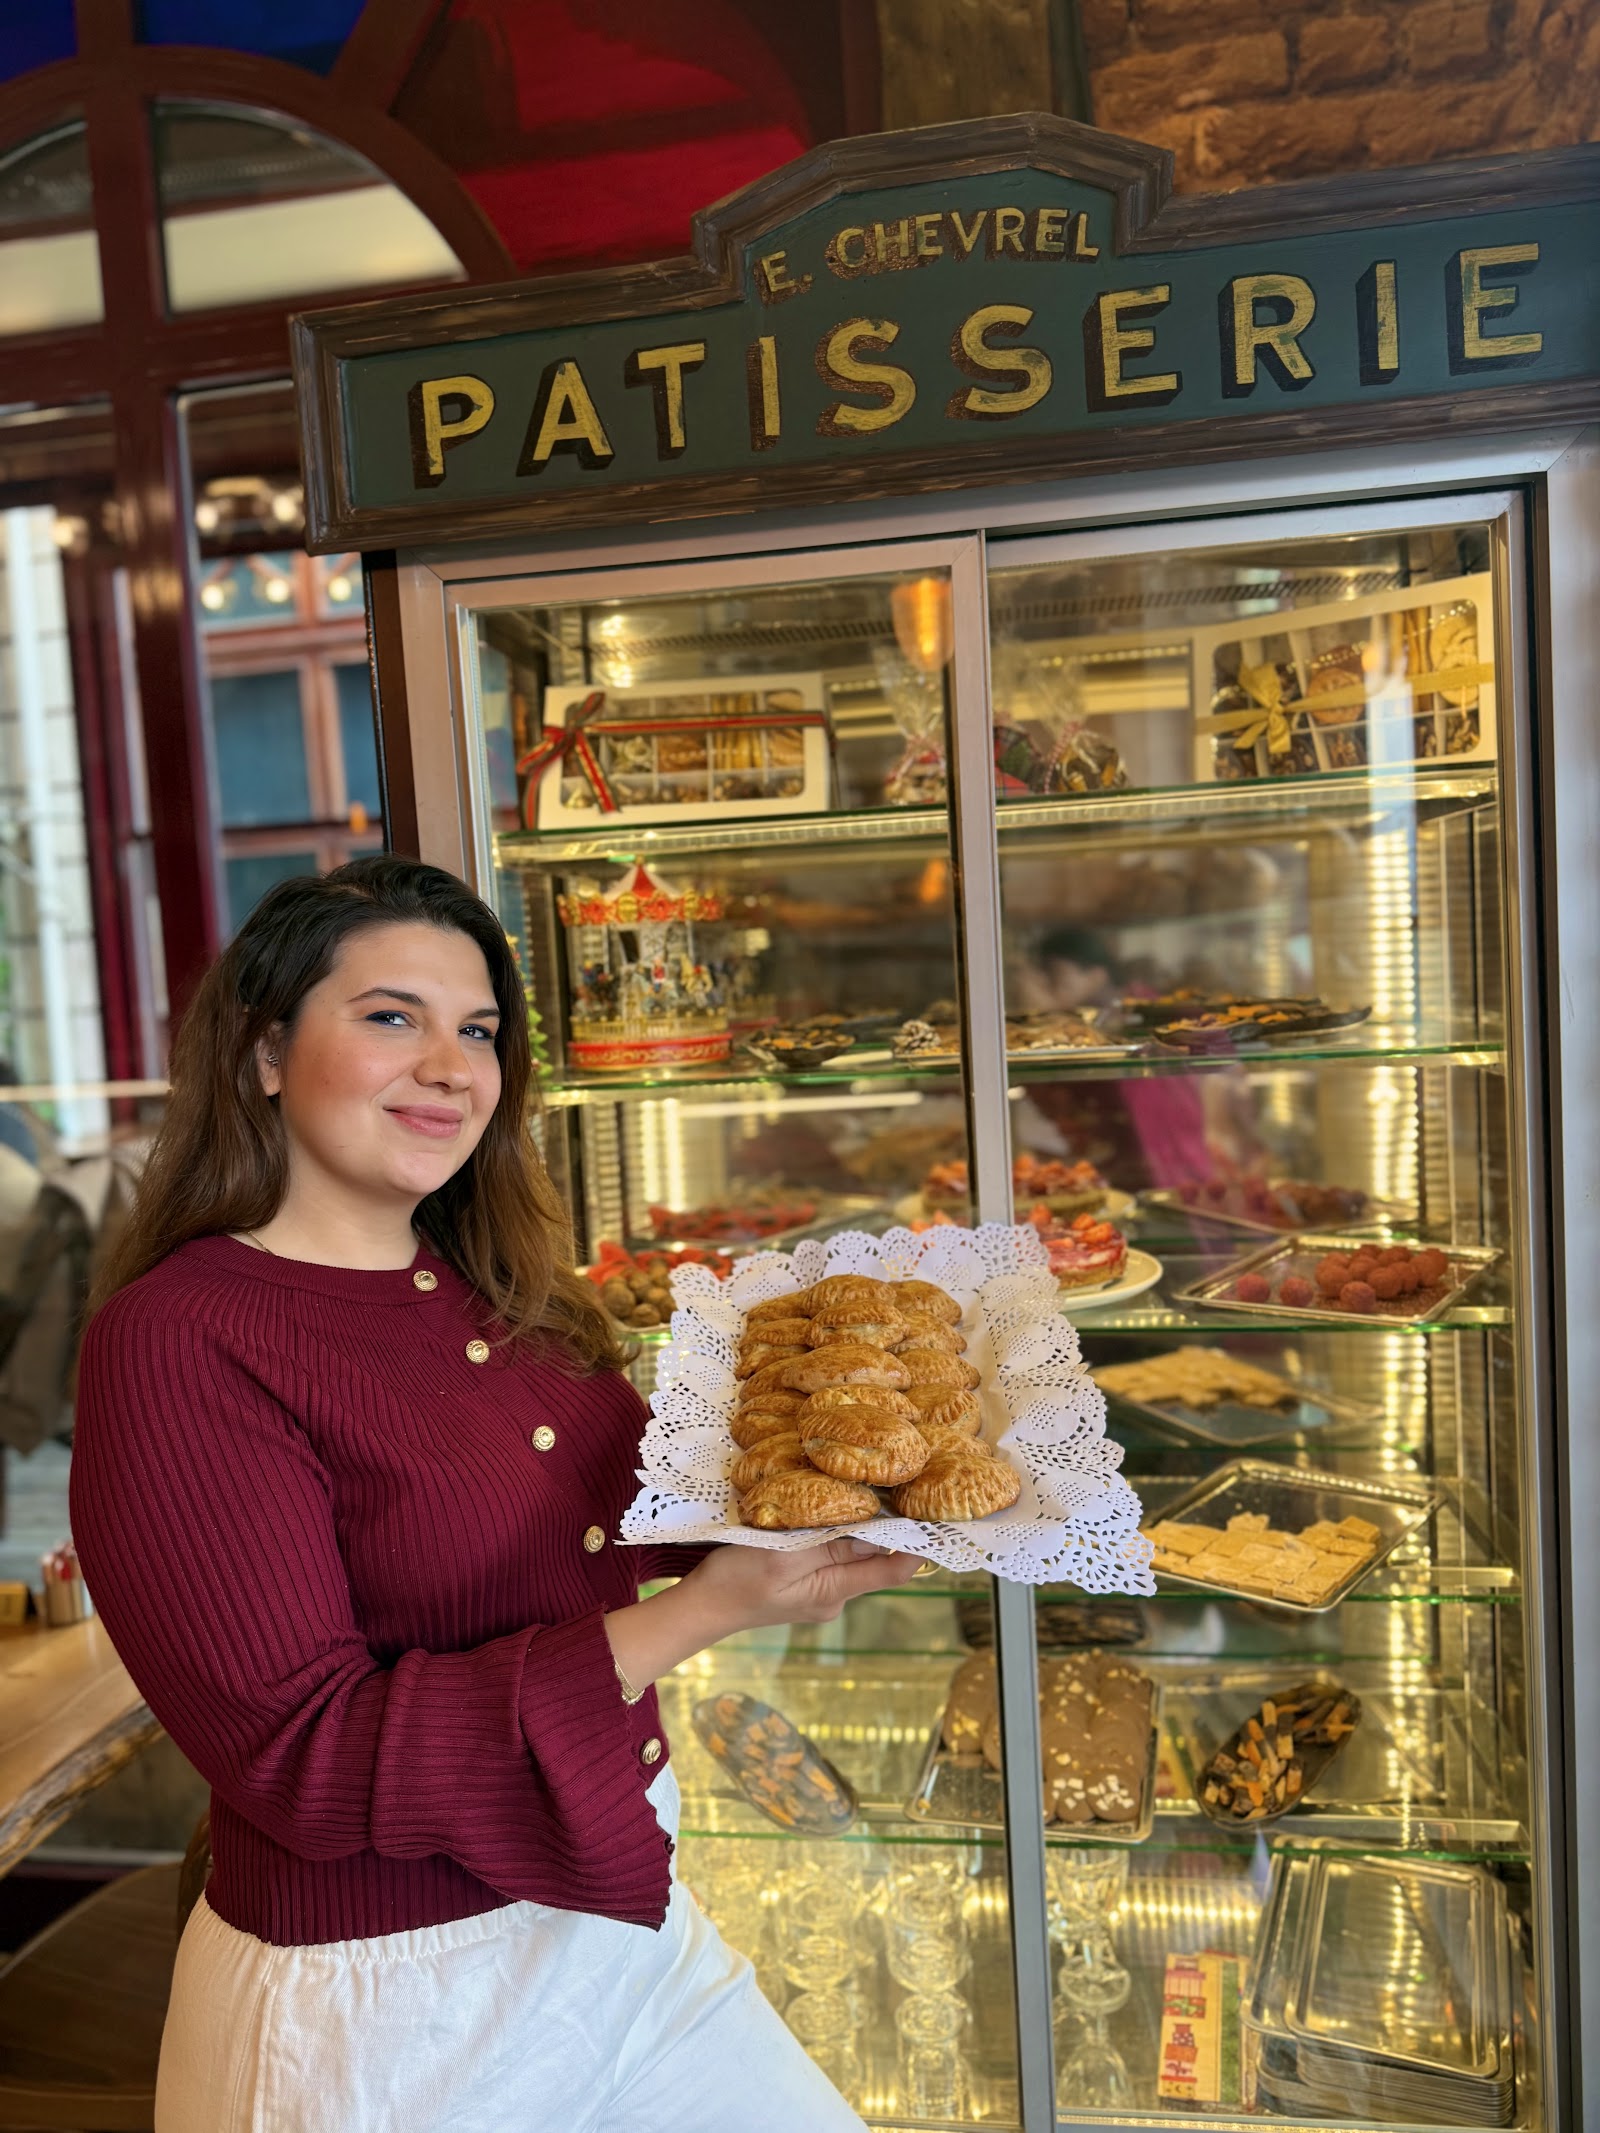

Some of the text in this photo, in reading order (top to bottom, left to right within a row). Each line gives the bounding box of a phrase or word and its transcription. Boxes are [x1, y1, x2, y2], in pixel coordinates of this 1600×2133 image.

[759, 206, 1100, 294] E. CHEVREL
[415, 243, 1544, 478] PATISSERIE
